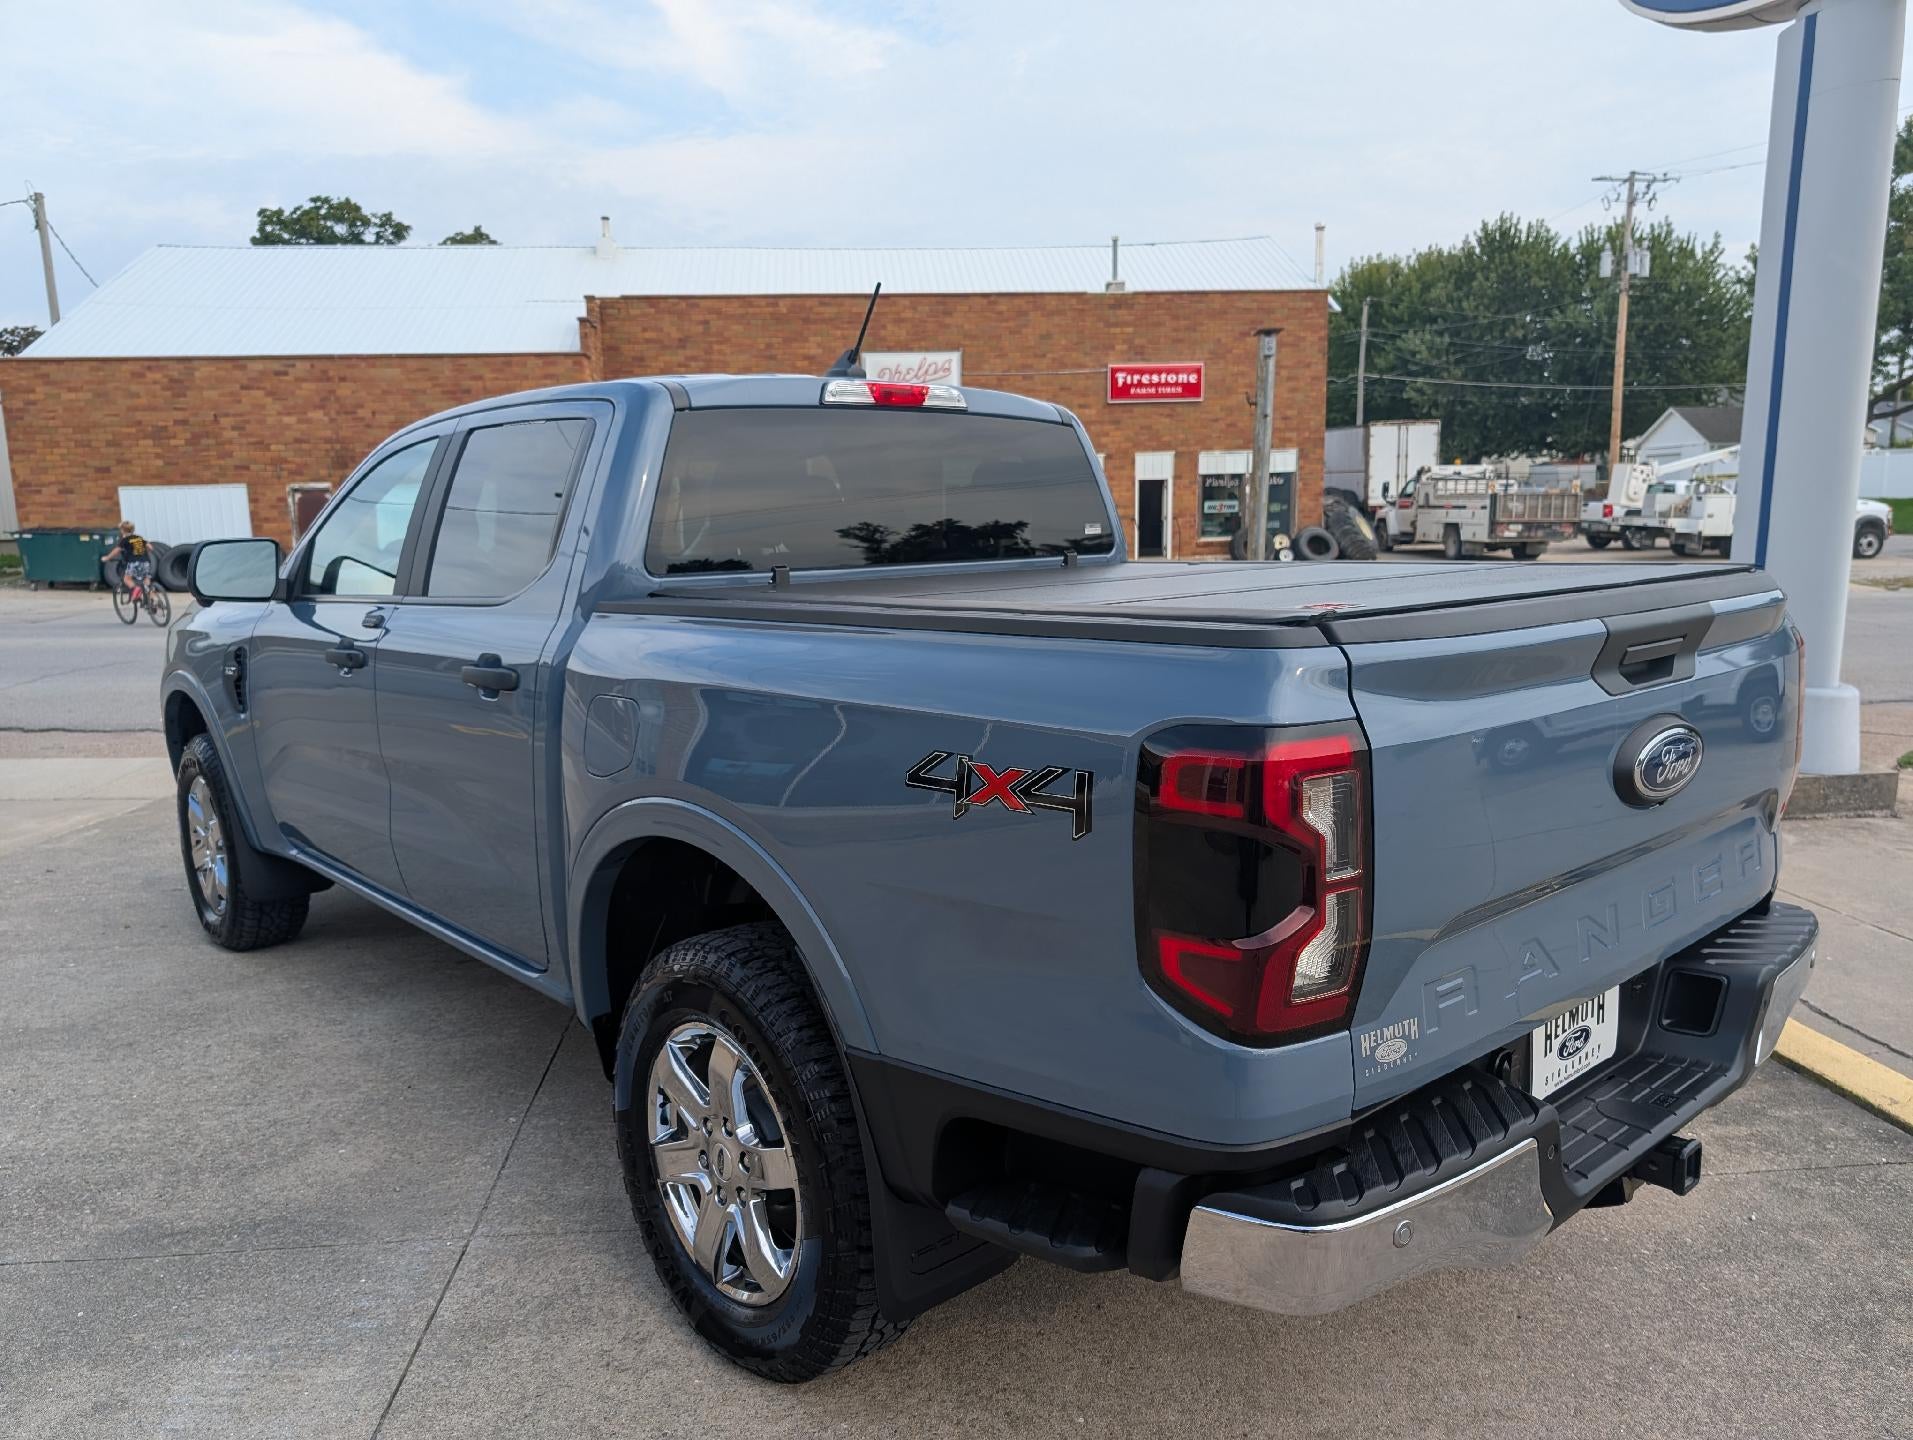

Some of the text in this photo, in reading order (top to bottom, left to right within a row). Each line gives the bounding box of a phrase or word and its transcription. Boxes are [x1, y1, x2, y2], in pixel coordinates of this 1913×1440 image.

[1115, 371, 1198, 388] Firestone
[1421, 835, 1763, 1035] RANGER
[1360, 1017, 1419, 1058] HELMUTH
[1544, 992, 1605, 1058] HELMUTH
